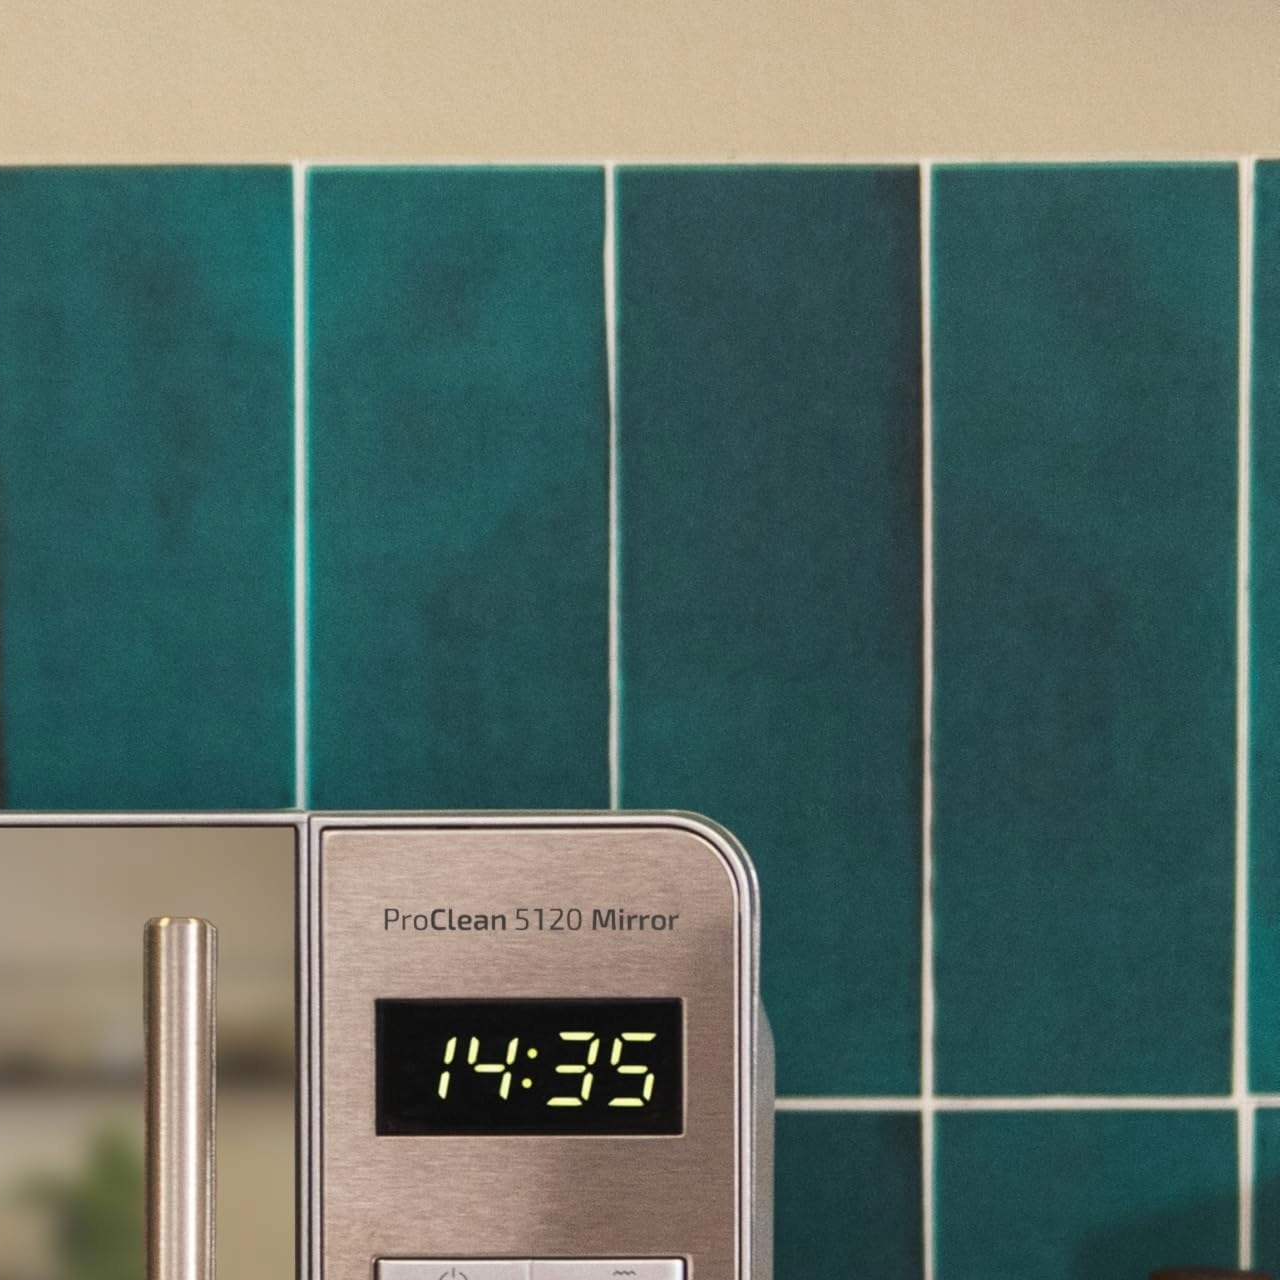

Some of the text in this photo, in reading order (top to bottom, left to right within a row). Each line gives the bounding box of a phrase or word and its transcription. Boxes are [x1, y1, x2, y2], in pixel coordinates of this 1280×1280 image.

[383, 907, 680, 932] ProClean 5120 Mirror
[437, 1031, 657, 1107] 14:35
